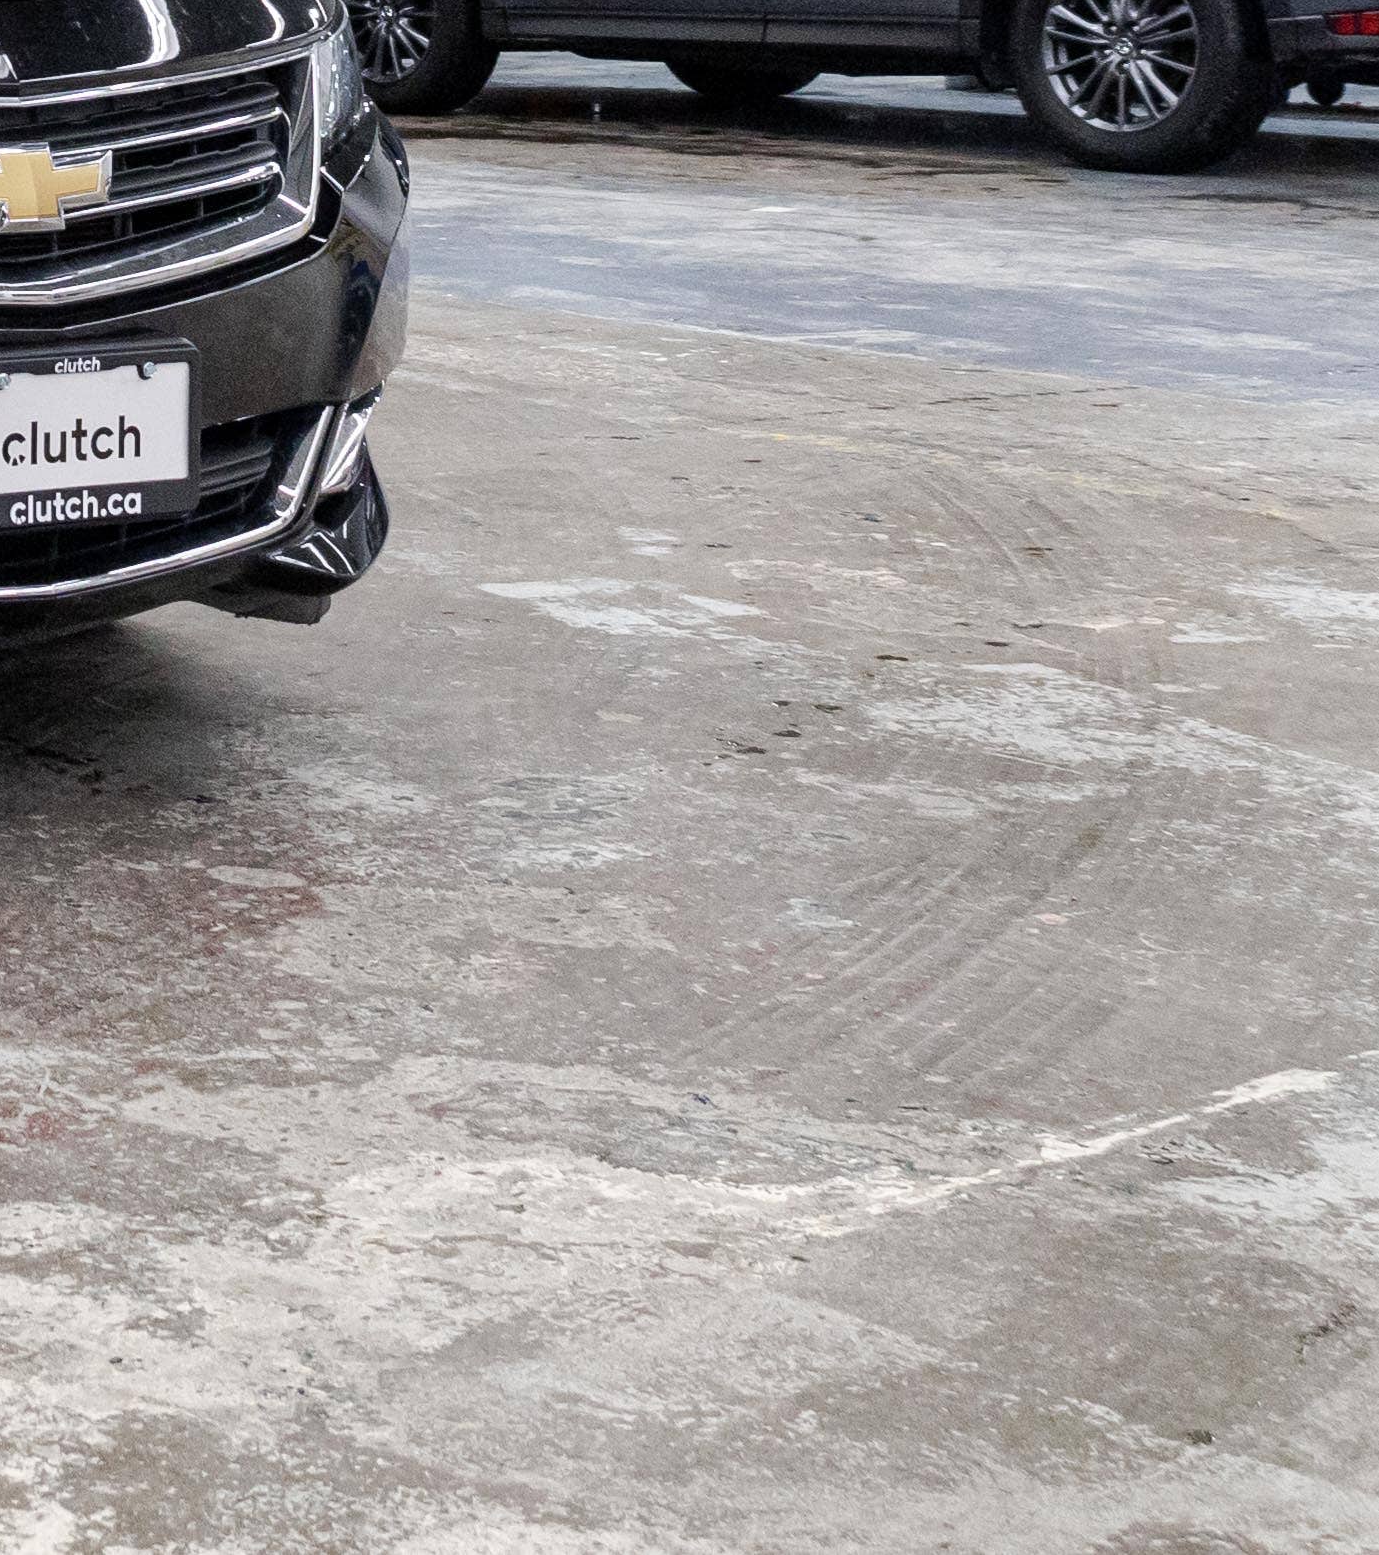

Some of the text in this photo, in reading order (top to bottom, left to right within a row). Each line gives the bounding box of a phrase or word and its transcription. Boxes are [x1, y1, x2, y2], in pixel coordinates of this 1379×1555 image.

[54, 356, 101, 374] clutch
[2, 415, 141, 466] clutch
[9, 489, 142, 525] clutch.ca
